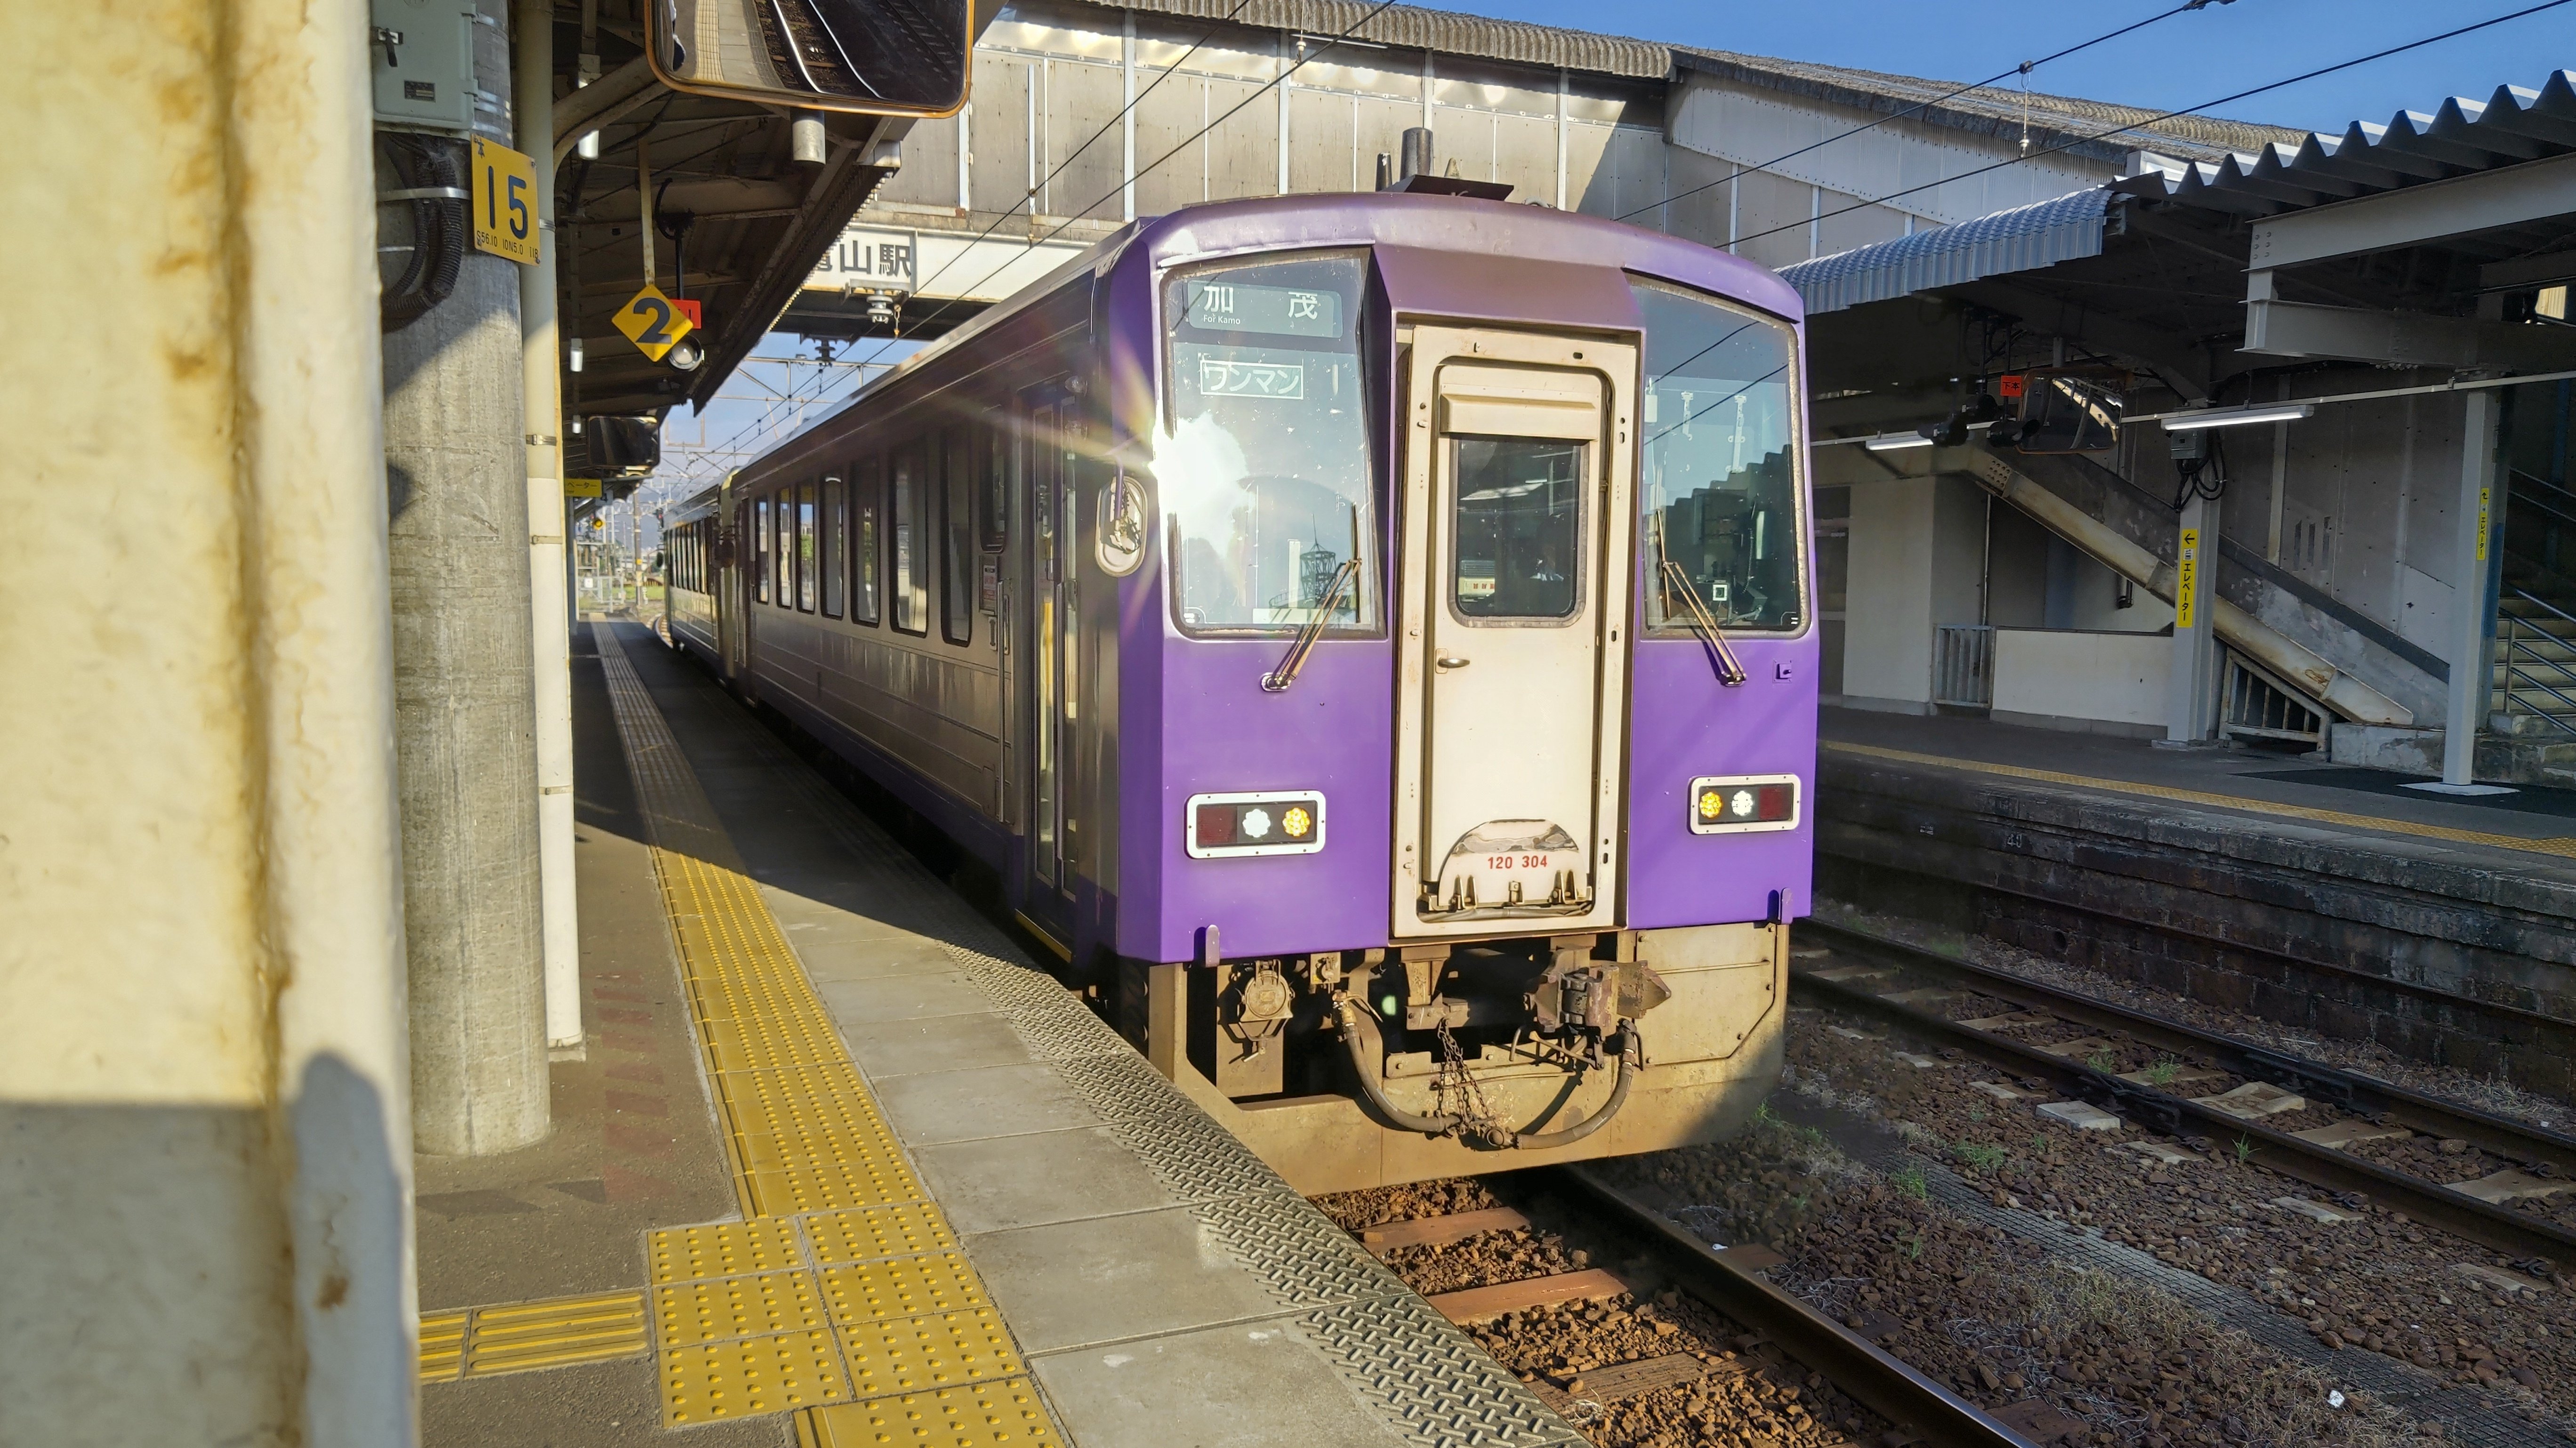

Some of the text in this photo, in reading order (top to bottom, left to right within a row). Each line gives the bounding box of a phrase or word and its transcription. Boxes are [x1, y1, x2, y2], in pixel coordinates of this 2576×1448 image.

[488, 166, 528, 240] 15
[633, 298, 672, 344] 2
[1203, 314, 1241, 325] For Kamo
[1204, 366, 1299, 394] ワンマン
[2182, 563, 2191, 621] エレベーター
[1488, 855, 1547, 869] 120 304
